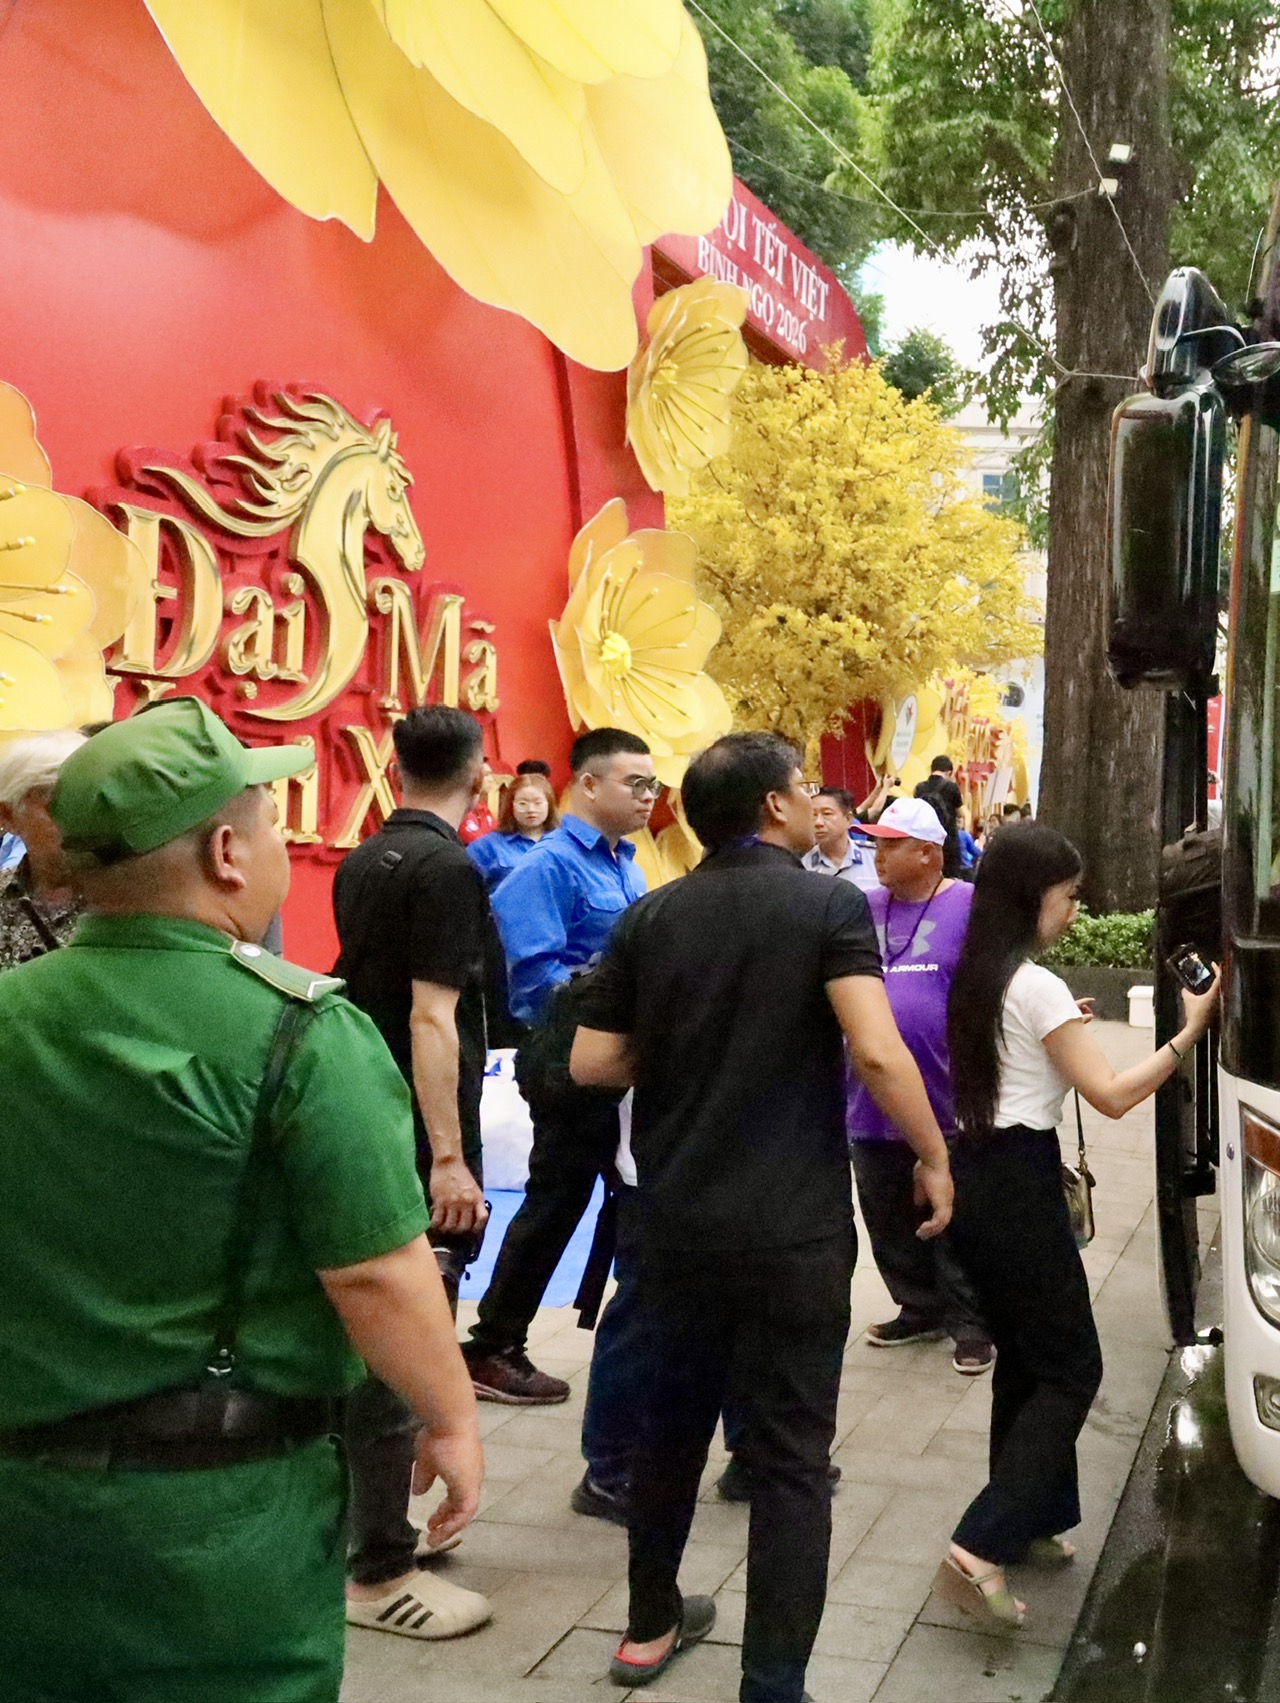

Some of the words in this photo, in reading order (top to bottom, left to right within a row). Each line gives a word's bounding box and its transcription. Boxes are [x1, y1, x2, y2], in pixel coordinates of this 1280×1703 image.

[698, 235, 739, 287] BÍNH
[777, 303, 807, 353] 2026
[752, 213, 788, 286] TẾT
[791, 252, 829, 322] VIỆT
[104, 502, 308, 700] Đại
[368, 576, 500, 712] Mã
[890, 964, 939, 973] ARMOUR
